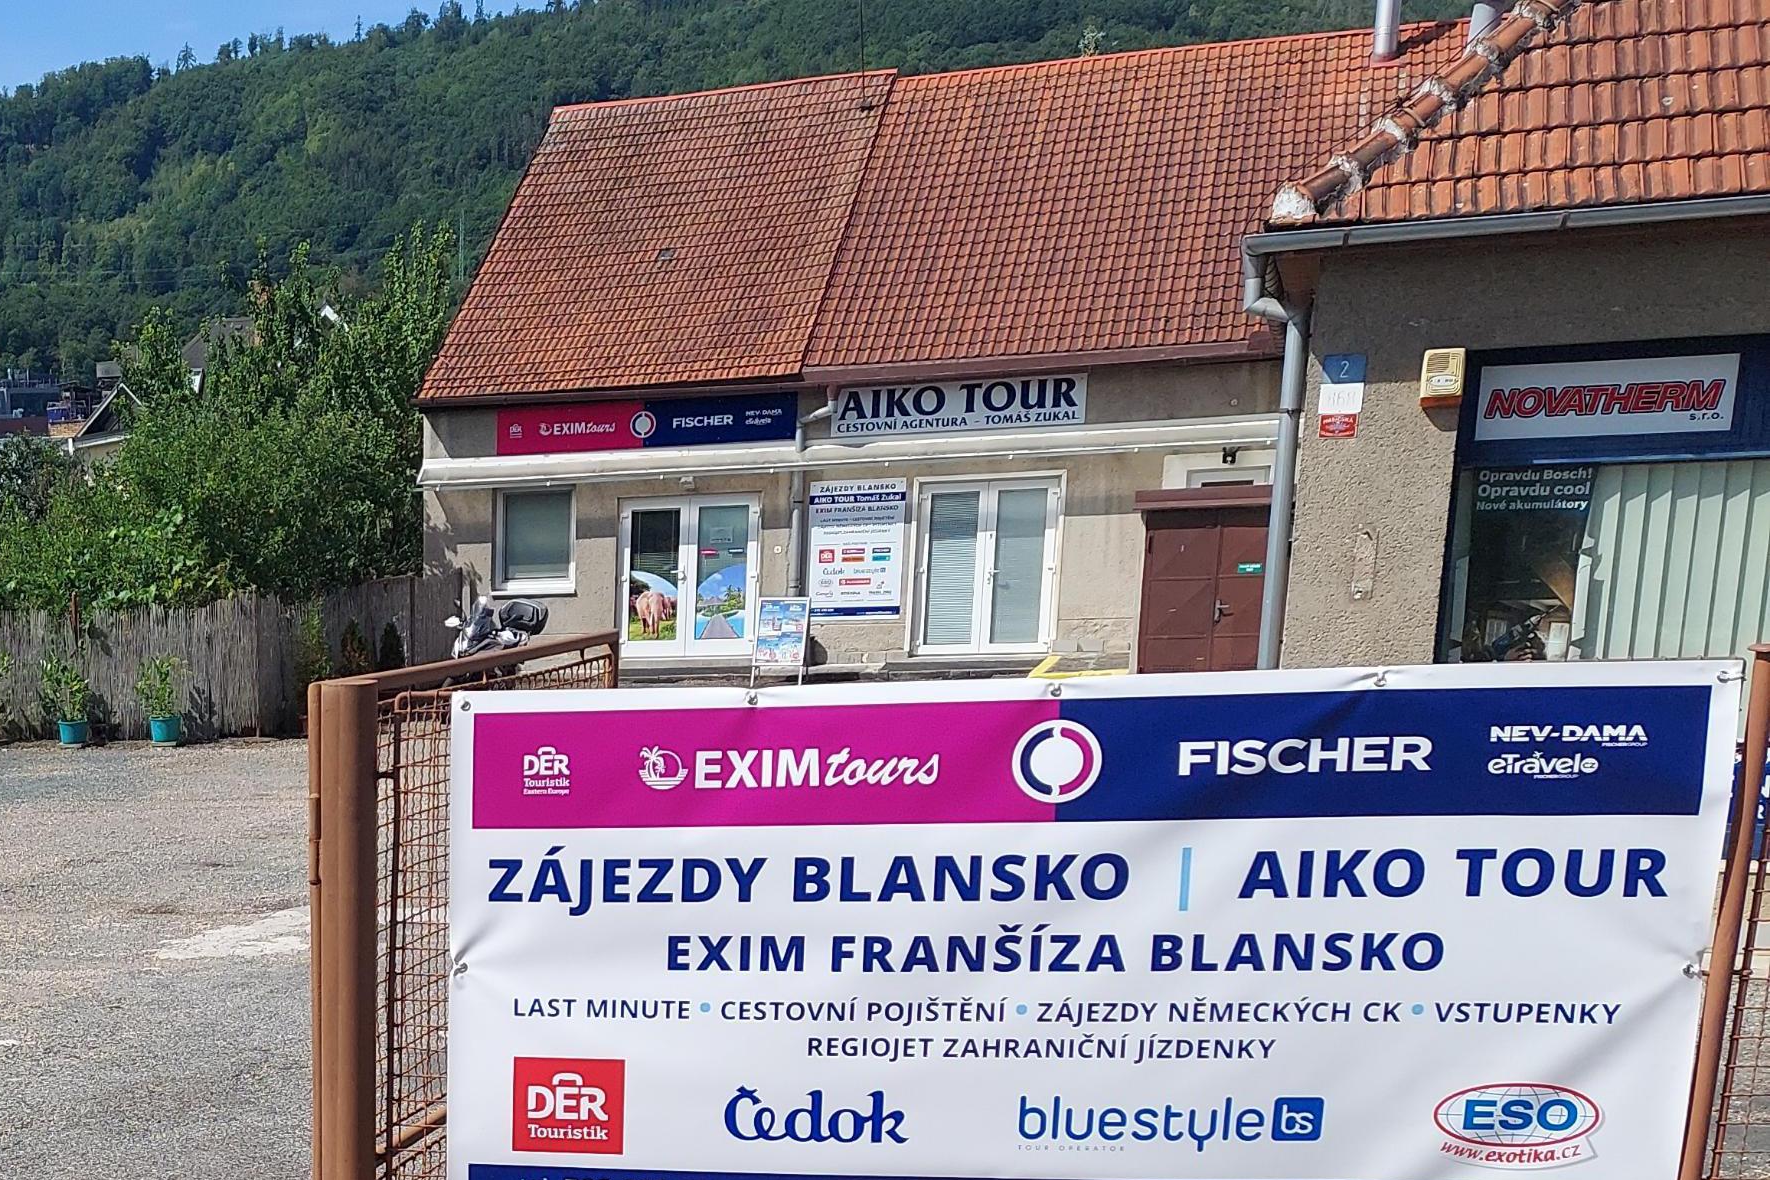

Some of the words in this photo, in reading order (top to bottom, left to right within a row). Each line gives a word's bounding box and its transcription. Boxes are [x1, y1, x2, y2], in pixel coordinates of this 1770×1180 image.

[1340, 360, 1350, 378] 2
[838, 385, 946, 420] AIKO
[959, 377, 1079, 413] TOUR
[1484, 379, 1726, 419] NOVATHERM
[672, 414, 733, 429] FISCHER
[837, 418, 897, 433] CESTOVNÍ
[901, 417, 968, 430] AGENTURA
[984, 411, 1031, 425] TOMÁŠ
[1034, 410, 1080, 422] ZUKAL
[1689, 412, 1724, 421] s.r.o.
[1480, 470, 1540, 482] Opravdu
[1543, 468, 1592, 481] Bosch!
[857, 483, 896, 491] BLANSKO
[1478, 483, 1550, 498] Opravdu
[1554, 482, 1590, 496] cool
[814, 496, 833, 504] AIKO
[834, 495, 855, 503] TOUR
[1476, 500, 1506, 511] Nové
[1509, 500, 1588, 511] akumulátory
[1490, 724, 1648, 742] NEV-DAMA
[523, 754, 570, 776] DER
[1177, 735, 1432, 776] FISCHER
[523, 777, 570, 788] Touristik
[488, 845, 768, 916] ZÁJEZDY
[793, 853, 1130, 902] BLANSKO
[1237, 848, 1425, 899] AIKO
[1456, 847, 1668, 898] TOUR
[667, 935, 805, 972] EXIM
[830, 923, 1125, 973] FRANŠÍZA
[1150, 932, 1444, 972] BLANSKO
[514, 998, 577, 1018] LAST
[586, 1000, 690, 1020] MINUTE
[721, 997, 858, 1022] CESTOVNÍ
[867, 997, 1009, 1027] POJIŠTĚNÍ
[1037, 997, 1158, 1028] ZÁJEZDY
[1168, 997, 1350, 1023] NĚMECKÝCH
[1363, 1002, 1402, 1022] CK
[1435, 1002, 1622, 1024] VSTUPENKY
[807, 1037, 934, 1062] REGIOJET
[943, 1033, 1129, 1059] ZAHRANIČNÍ
[1134, 1033, 1276, 1064] JÍZDENKY
[527, 1084, 608, 1121] DER
[724, 1085, 909, 1144] Čedok
[1018, 1095, 1265, 1152] bluestyle
[1281, 1103, 1315, 1134] bs
[1461, 1098, 1579, 1132] ESO
[527, 1123, 608, 1141] Touristik
[1440, 1139, 1581, 1164] www.exotika.cz
